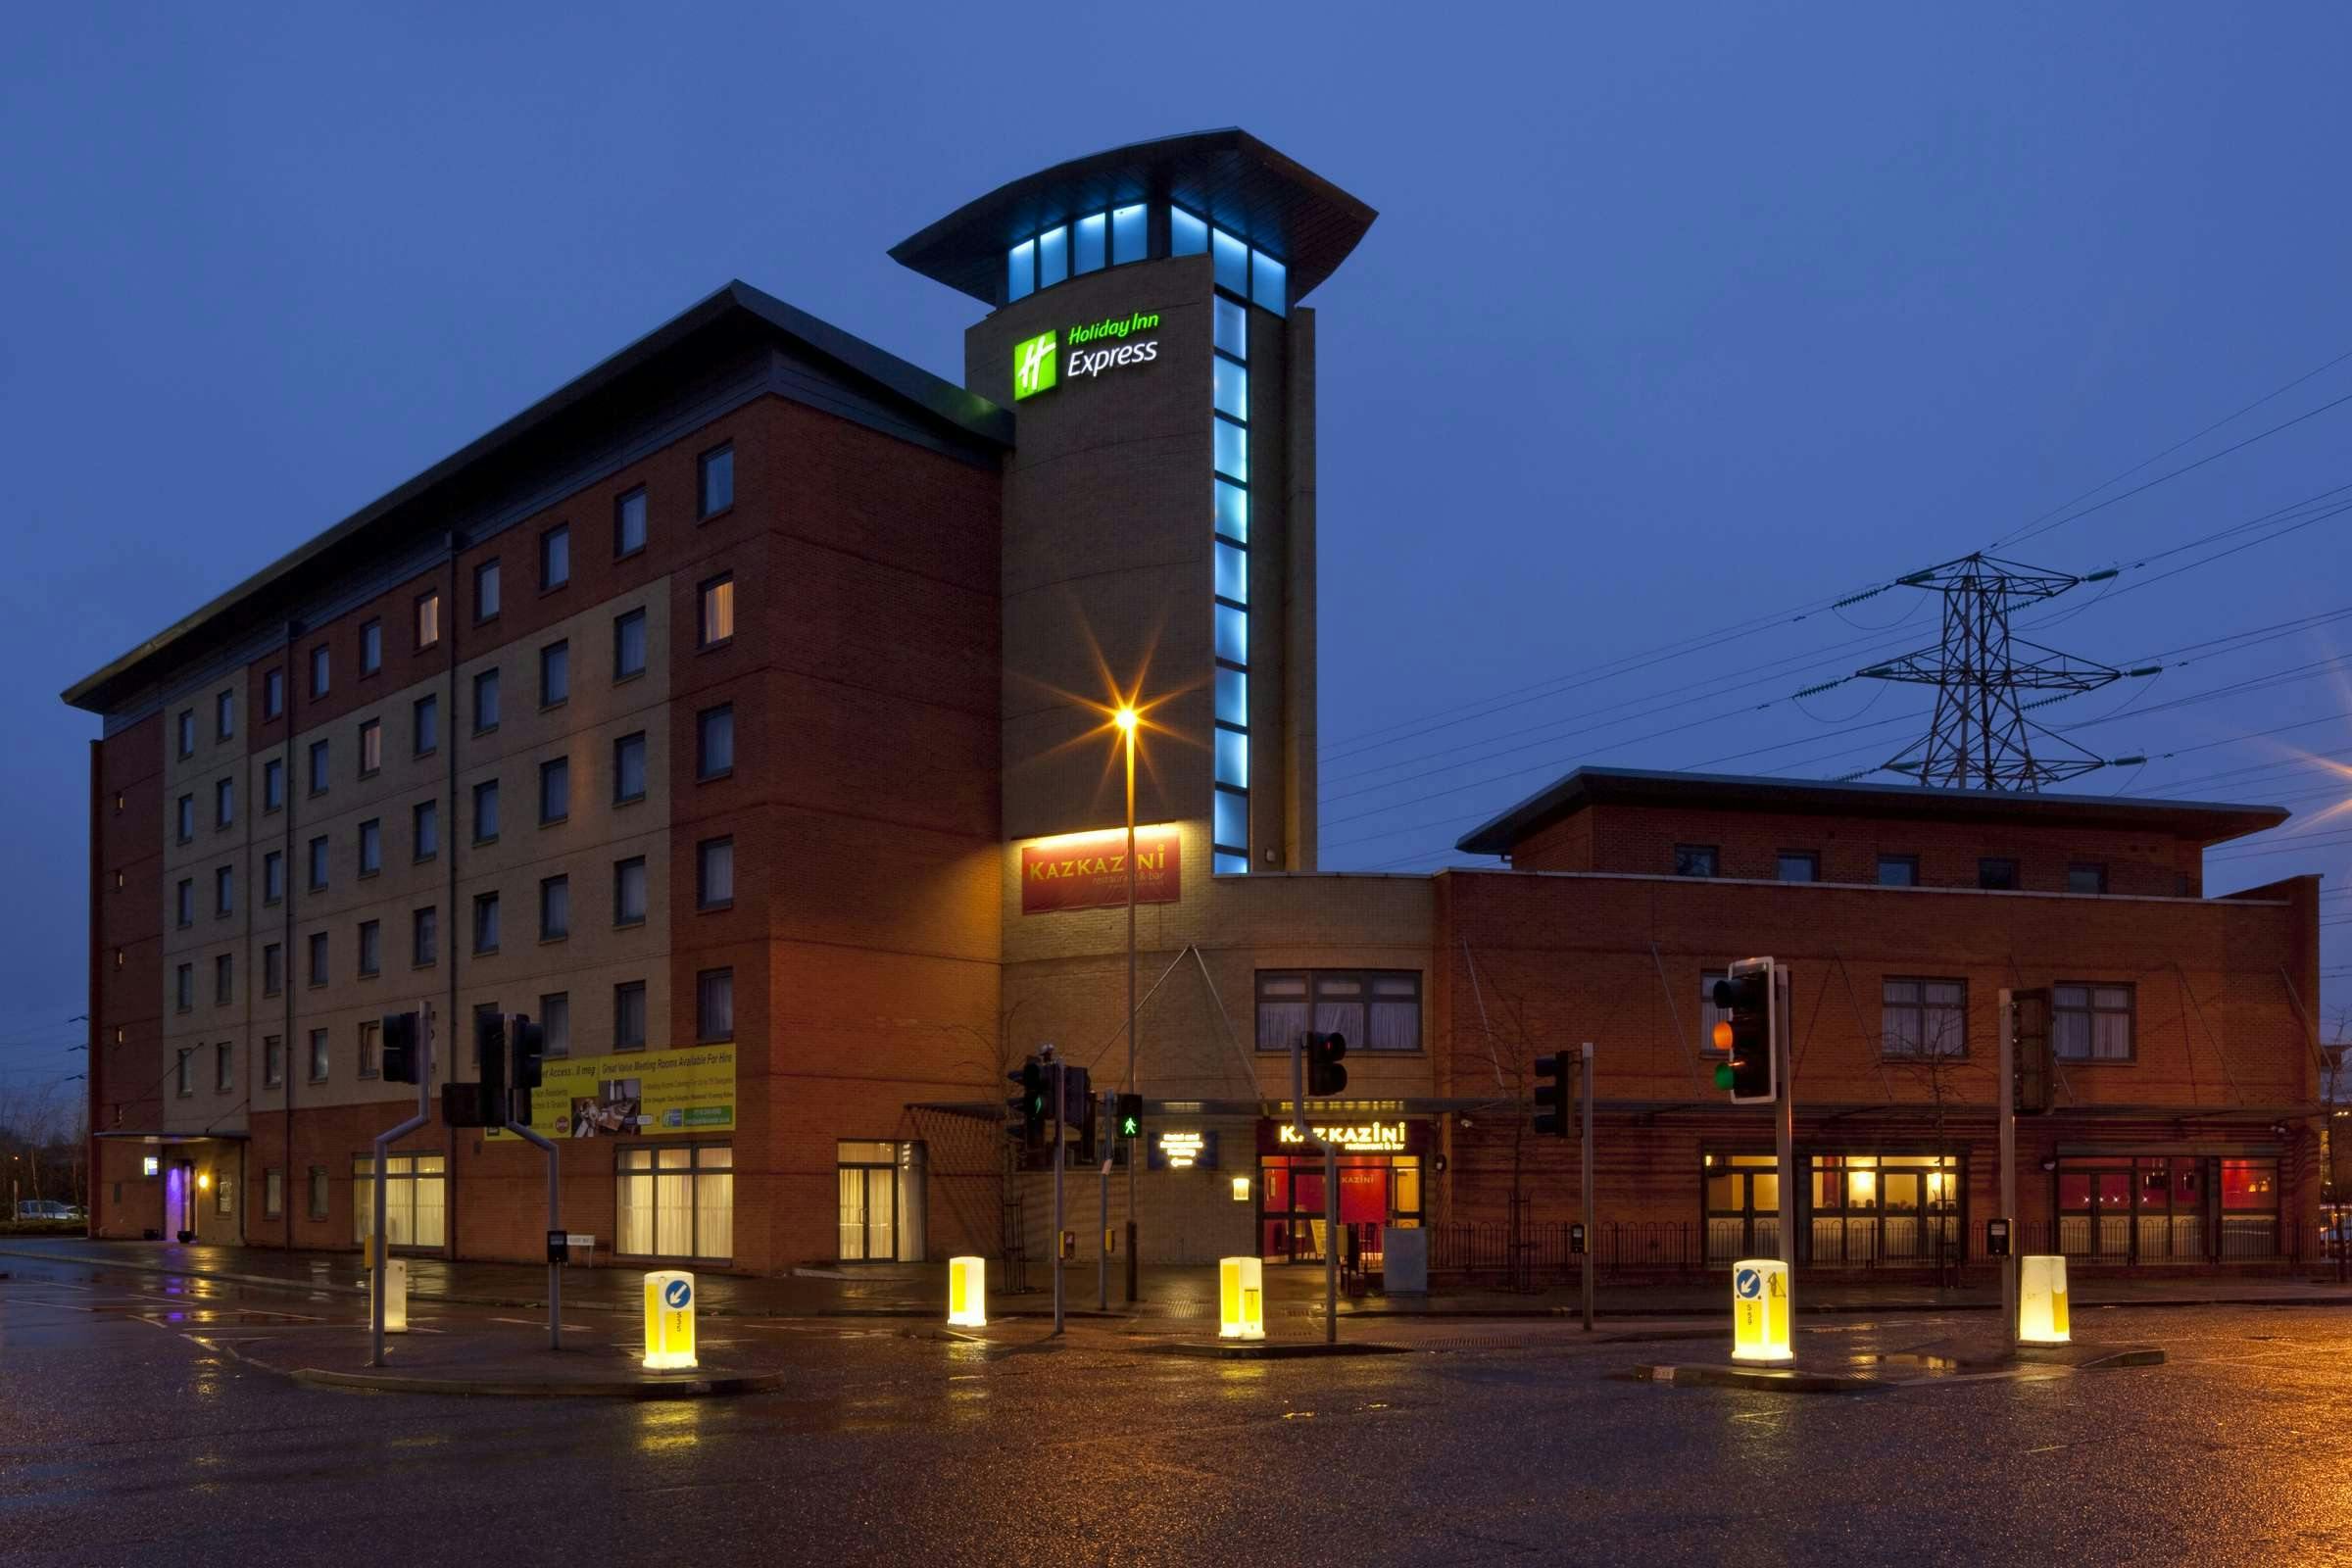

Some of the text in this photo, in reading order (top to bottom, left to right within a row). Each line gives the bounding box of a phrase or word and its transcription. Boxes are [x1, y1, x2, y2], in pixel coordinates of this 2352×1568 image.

[1068, 313, 1159, 346] Holiday Inn
[1067, 340, 1158, 377] Express
